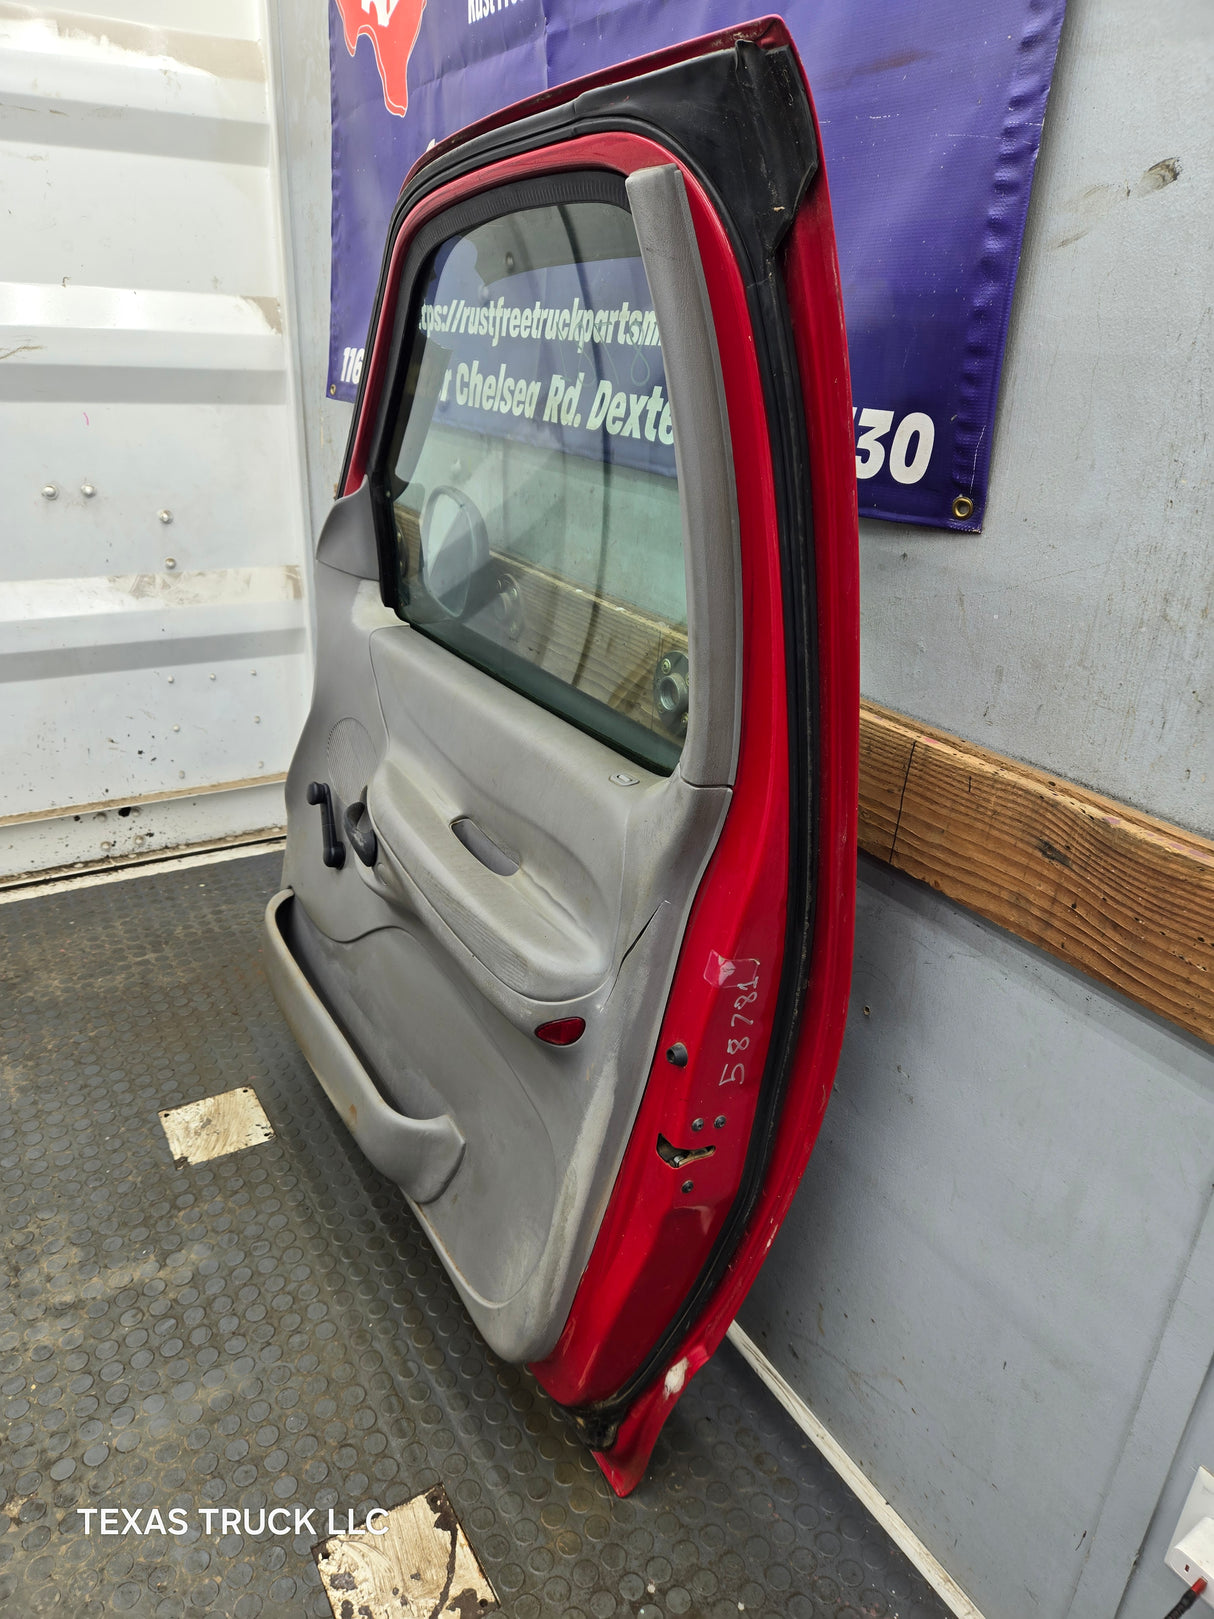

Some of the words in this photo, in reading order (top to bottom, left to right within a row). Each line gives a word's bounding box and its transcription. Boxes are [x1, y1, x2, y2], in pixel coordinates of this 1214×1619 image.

[456, 360, 542, 419] Chelsea
[543, 372, 585, 428] Rd.
[852, 406, 935, 485] 30
